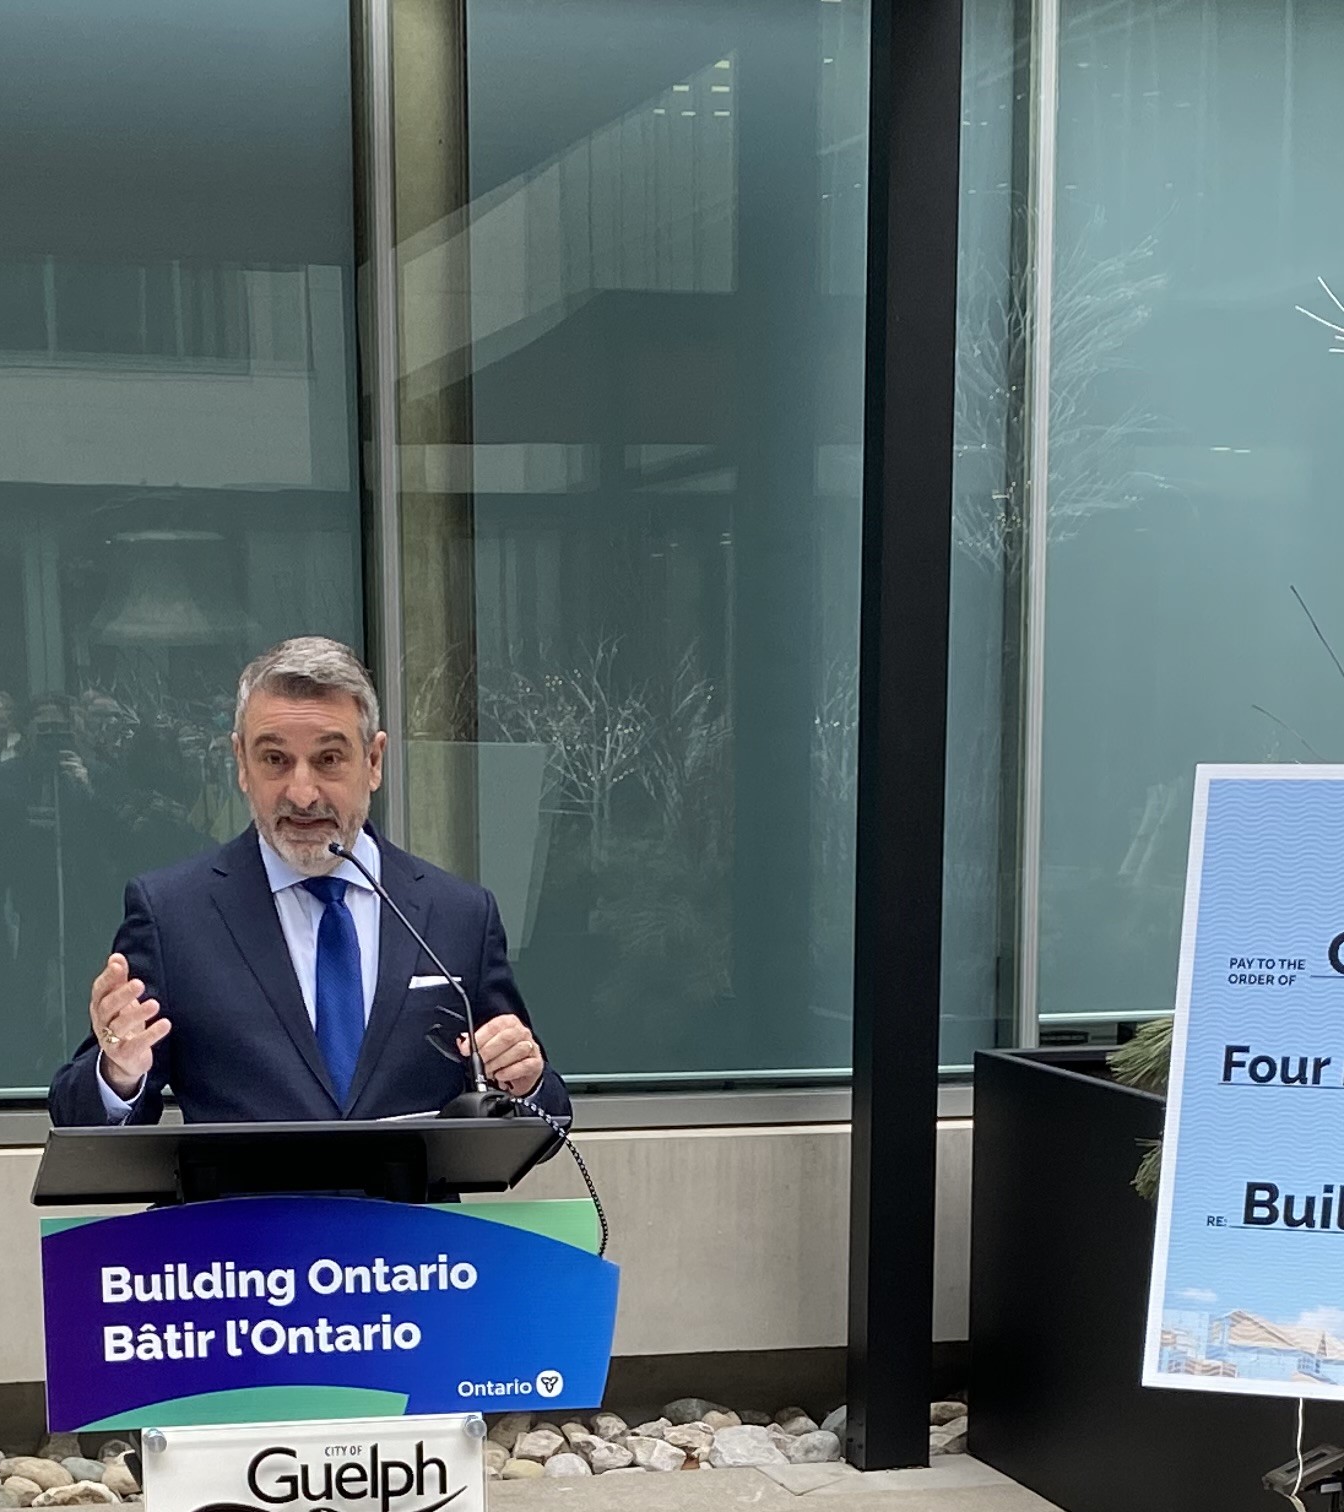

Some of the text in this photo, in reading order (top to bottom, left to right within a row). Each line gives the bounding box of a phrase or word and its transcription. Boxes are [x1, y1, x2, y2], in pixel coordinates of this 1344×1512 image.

[1229, 957, 1306, 971] PAY TO THE
[1228, 974, 1297, 986] ORDER OF
[1222, 1045, 1331, 1085] Four
[1206, 1215, 1227, 1227] RE:
[101, 1253, 478, 1306] Building Ontario
[102, 1314, 422, 1362] Bâtir l'Ontario
[457, 1377, 533, 1398] Ontario
[324, 1445, 363, 1457] CITY OF
